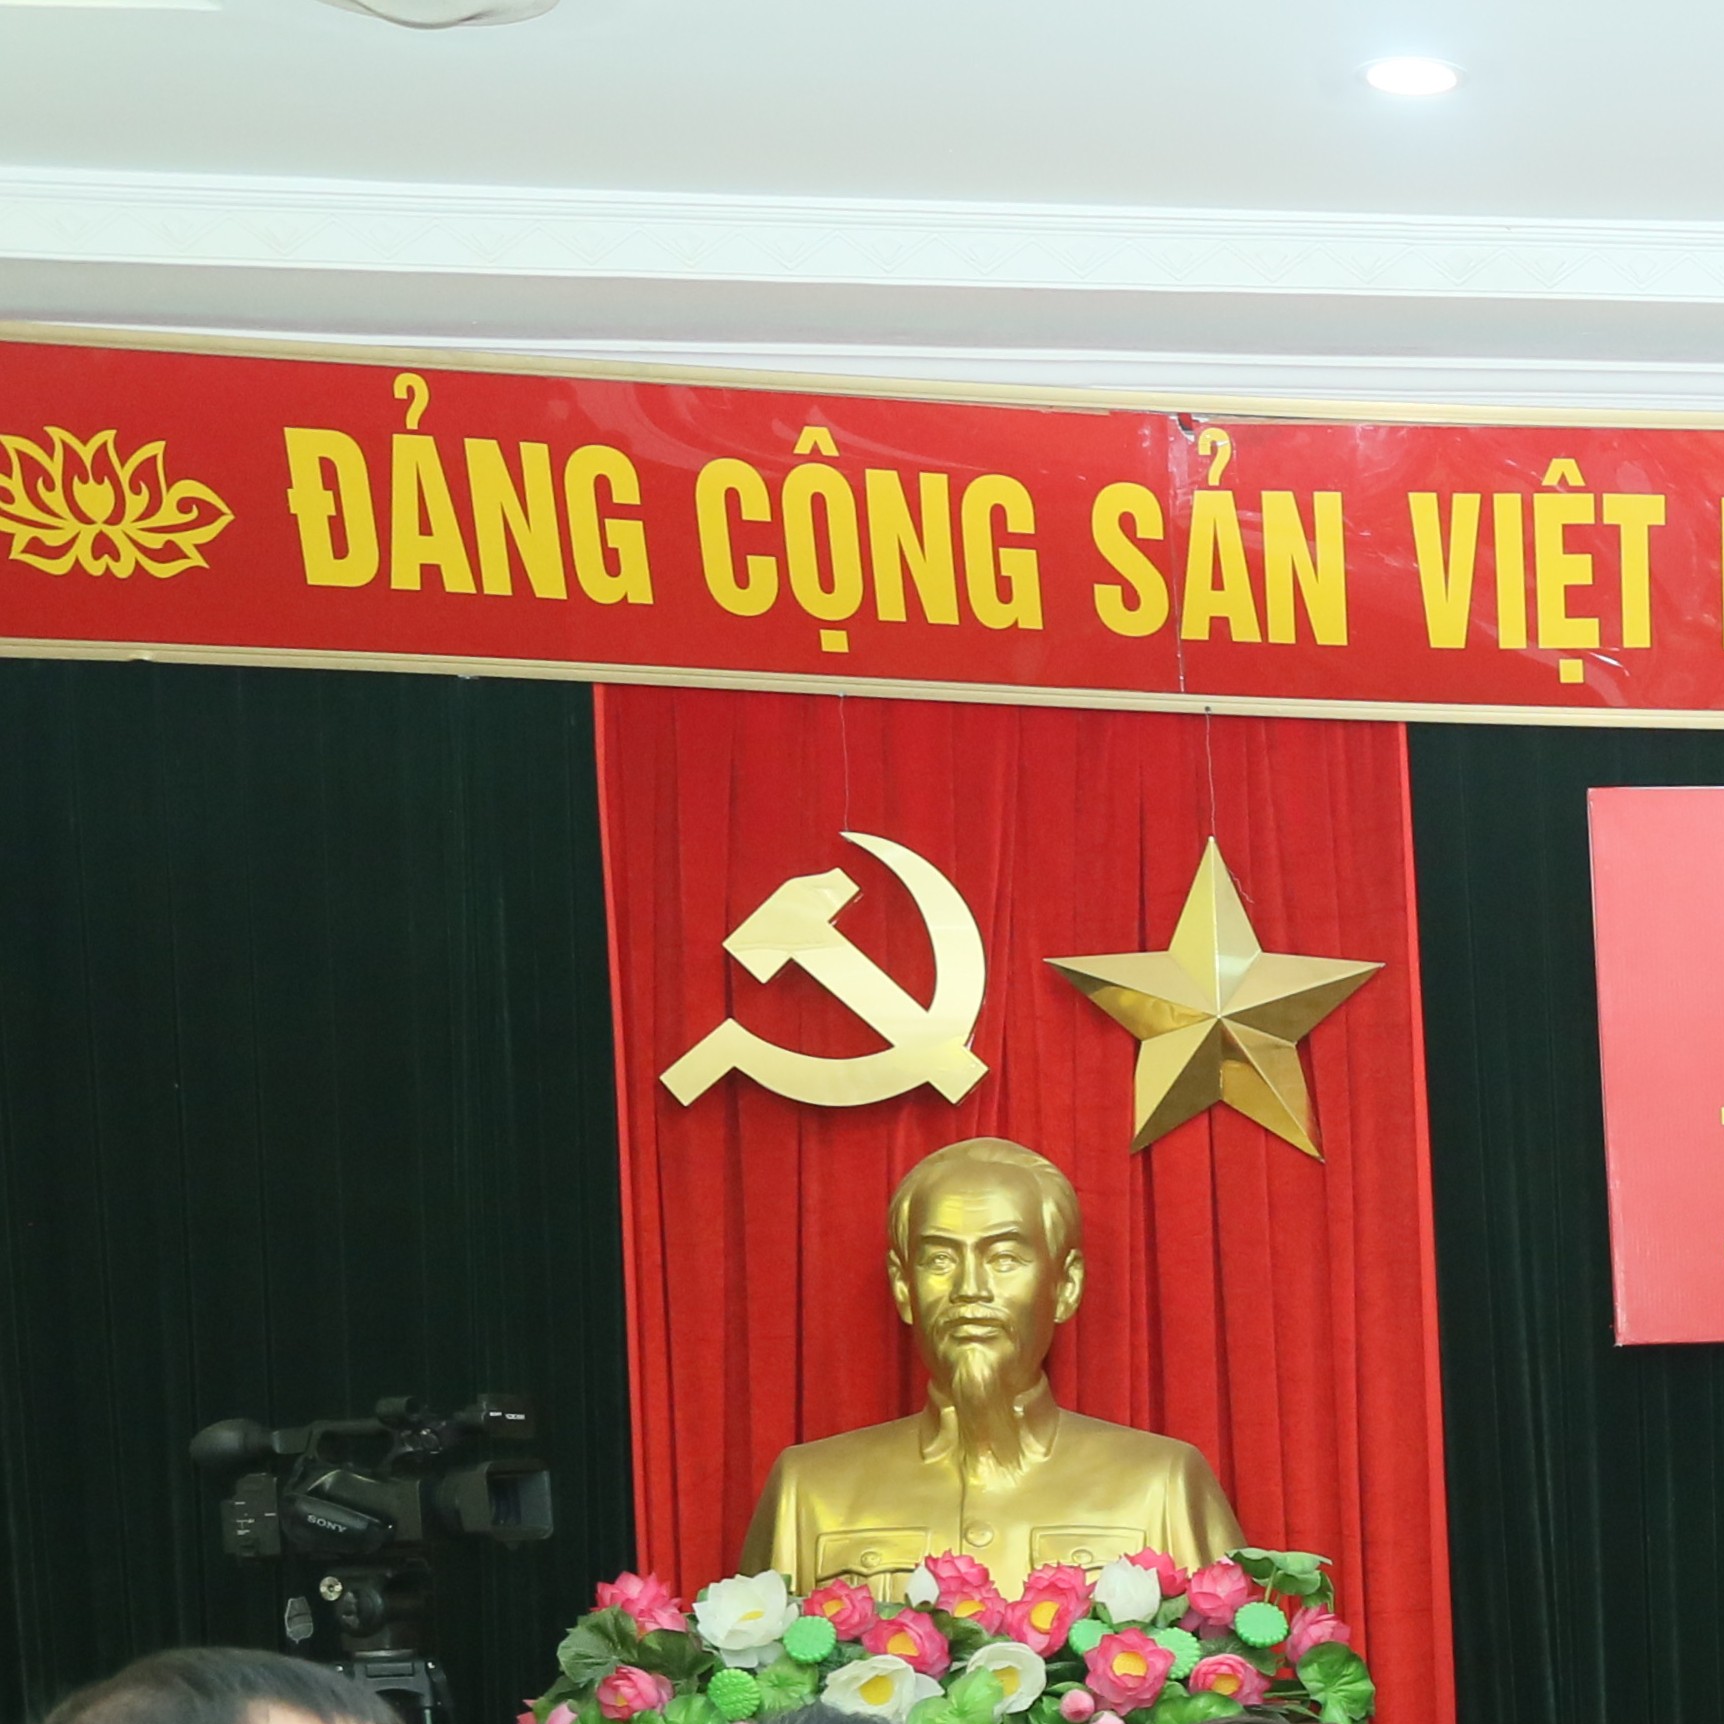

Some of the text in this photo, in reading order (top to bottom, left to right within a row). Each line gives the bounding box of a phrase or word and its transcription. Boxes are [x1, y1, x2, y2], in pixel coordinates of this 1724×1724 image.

[285, 371, 653, 604] ĐẢNG
[696, 426, 1042, 652] CỘNG
[1092, 428, 1348, 647] SẢN
[1408, 458, 1665, 683] VIỆT
[307, 1513, 348, 1533] SONY
